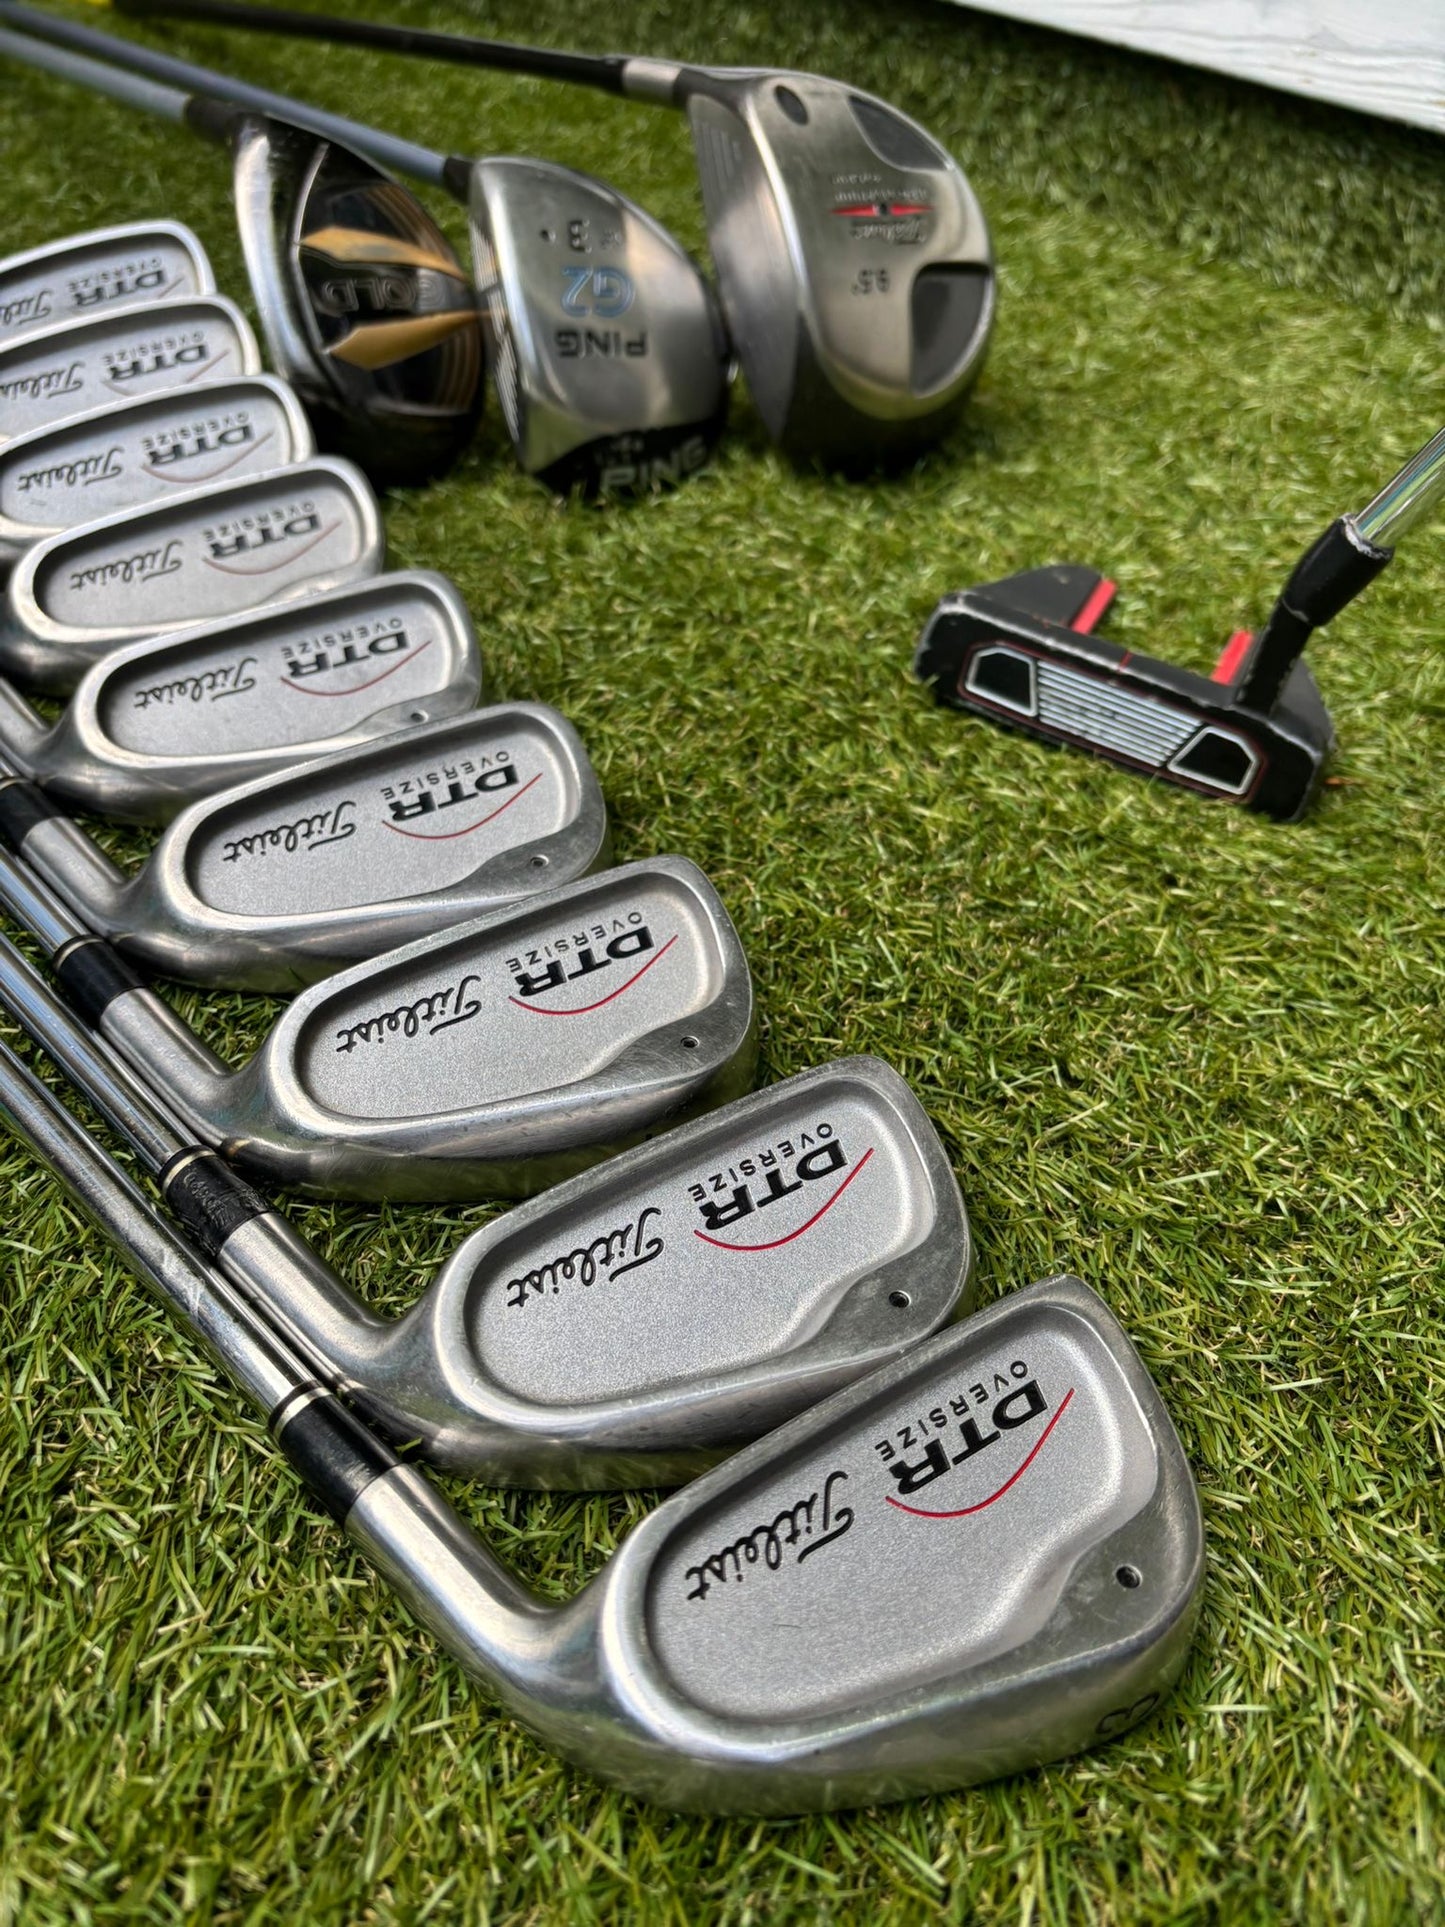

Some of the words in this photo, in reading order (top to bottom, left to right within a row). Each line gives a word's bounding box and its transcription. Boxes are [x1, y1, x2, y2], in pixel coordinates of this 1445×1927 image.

[68, 258, 161, 292] OVERSIZE
[73, 269, 165, 306] DTR
[561, 266, 636, 318] G2
[103, 332, 204, 365] OVERSIZE
[109, 344, 209, 380] DTR
[555, 329, 647, 358] PING
[141, 411, 249, 450] OVERSIZE
[149, 424, 255, 465] DTR
[17, 448, 125, 492] Titleist
[600, 434, 708, 494] PING
[202, 502, 315, 542] OVERSIZE
[209, 514, 322, 559] DTR
[70, 539, 183, 591] Titleist
[281, 617, 402, 658] OVERSIZE
[288, 631, 410, 678] DTR
[133, 657, 257, 710] Titleist
[380, 750, 510, 800] OVERSIZE
[388, 764, 520, 822] DTR
[223, 800, 357, 862] Titleist
[505, 911, 642, 974] OVERSIZE
[514, 926, 655, 997] DTR
[336, 974, 482, 1053] Titleist
[687, 1122, 834, 1202] OVERSIZE
[699, 1138, 849, 1231] DTR
[507, 1206, 665, 1307] Titleist
[874, 1359, 1029, 1462] OVERSIZE
[888, 1379, 1049, 1495] DTR
[684, 1470, 855, 1601] Titleist
